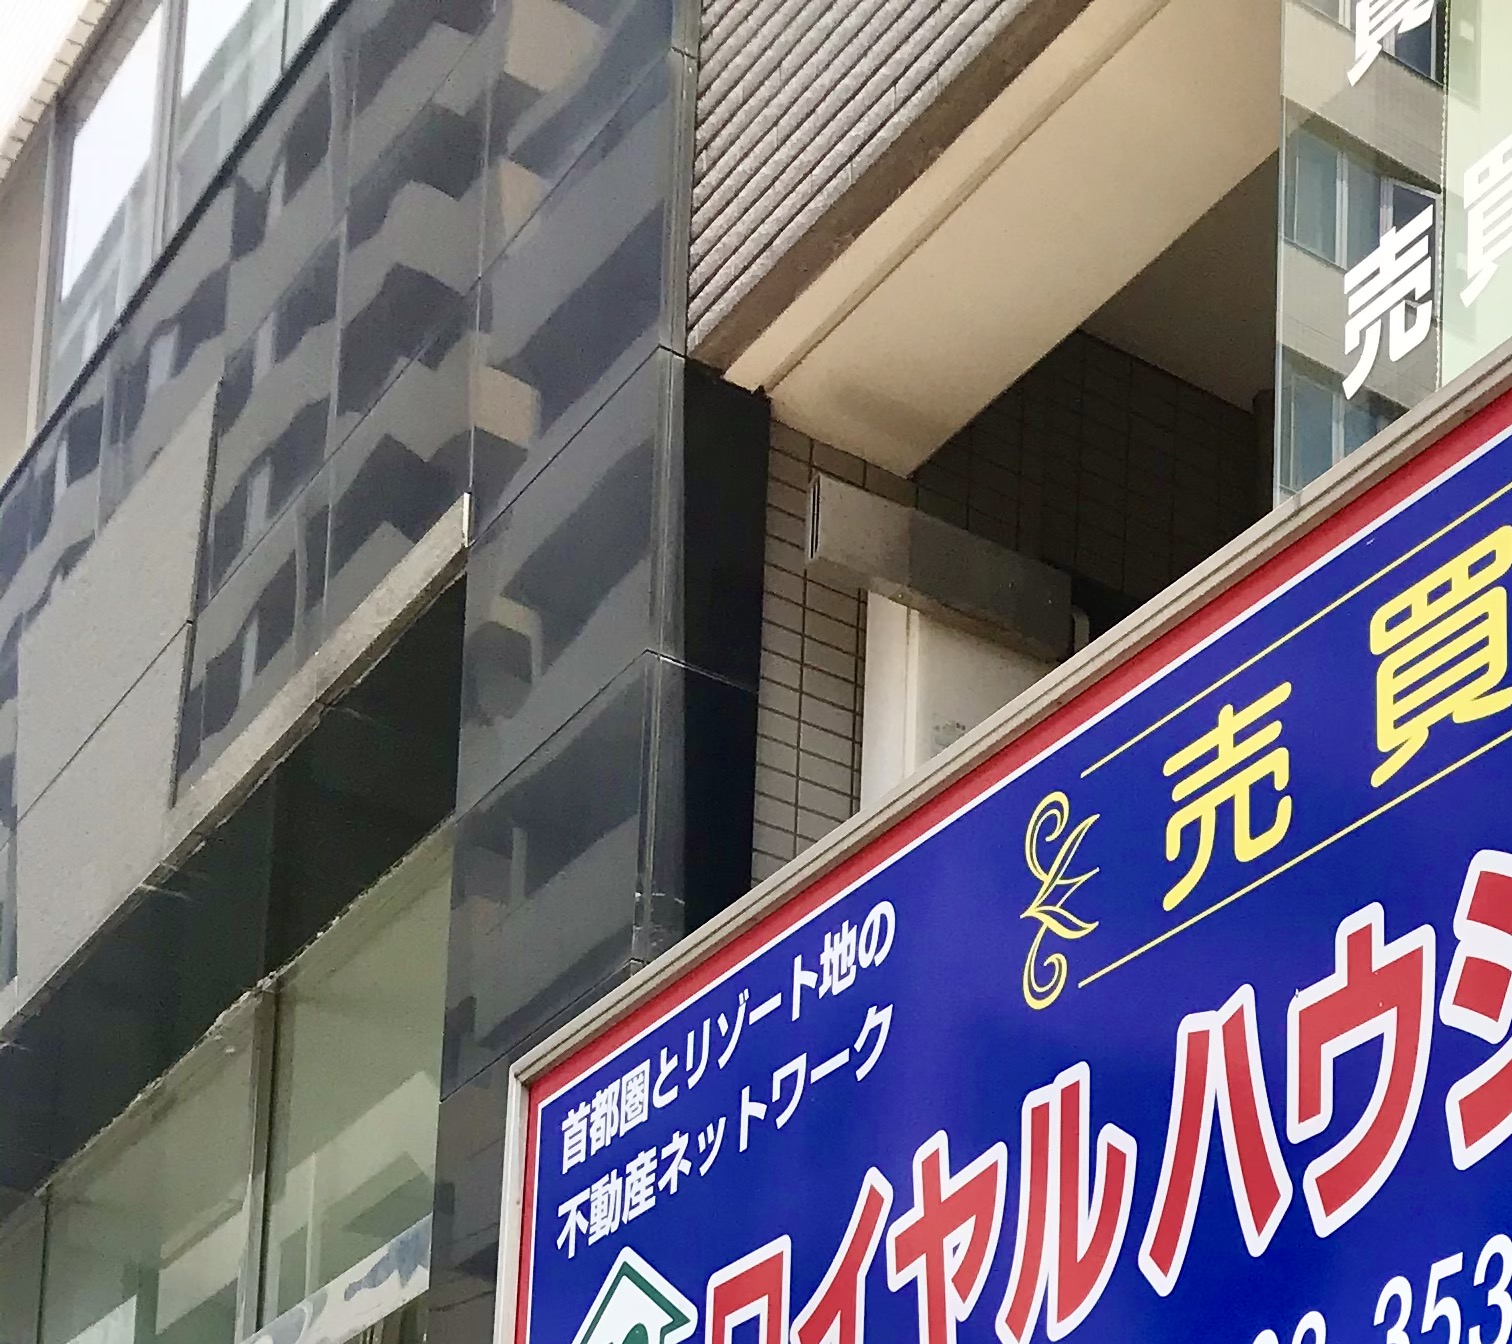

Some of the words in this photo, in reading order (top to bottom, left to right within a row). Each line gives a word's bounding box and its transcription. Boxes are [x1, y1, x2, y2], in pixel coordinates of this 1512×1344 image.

[556, 1002, 895, 1260] 不動産ネットワーク
[561, 900, 896, 1174] 首都圏とリゾート地の
